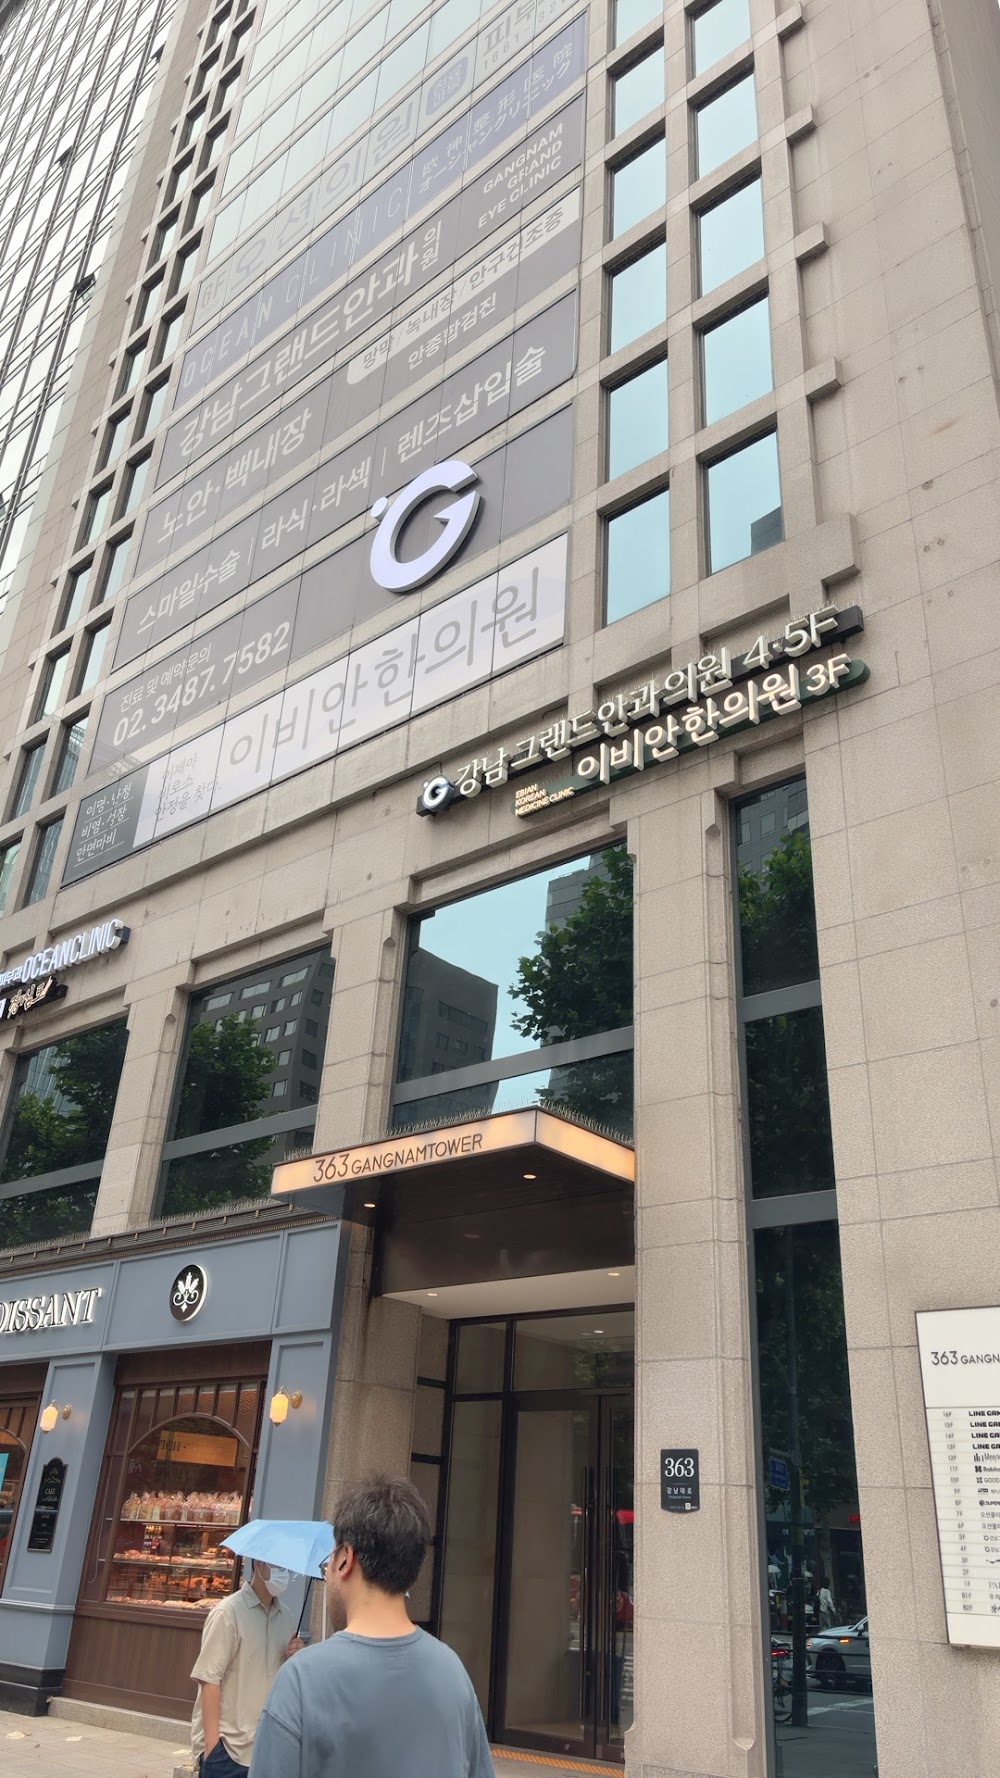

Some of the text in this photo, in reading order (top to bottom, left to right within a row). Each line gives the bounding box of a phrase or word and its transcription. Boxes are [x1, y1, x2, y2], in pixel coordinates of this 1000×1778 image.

[483, 122, 564, 195] GANGNAM
[507, 141, 563, 190] GRAND
[478, 155, 562, 229] EYE CLINIC
[181, 187, 402, 389] OCEAN CLINIC
[408, 292, 497, 371] 안종합검진
[397, 345, 547, 464] 렌즈삽입술
[120, 643, 213, 713] 진료 및 예약문의
[229, 567, 540, 775] 이비안한의원
[577, 653, 852, 785] 이비안한의원 3F
[515, 783, 539, 799] EBIAN
[515, 789, 547, 807] KOREAN
[515, 786, 575, 816] MEDICINE CLINIC
[76, 827, 117, 862] 안면마비
[313, 1153, 351, 1183] 363
[930, 1350, 959, 1366] 363
[664, 1457, 695, 1478] 363
